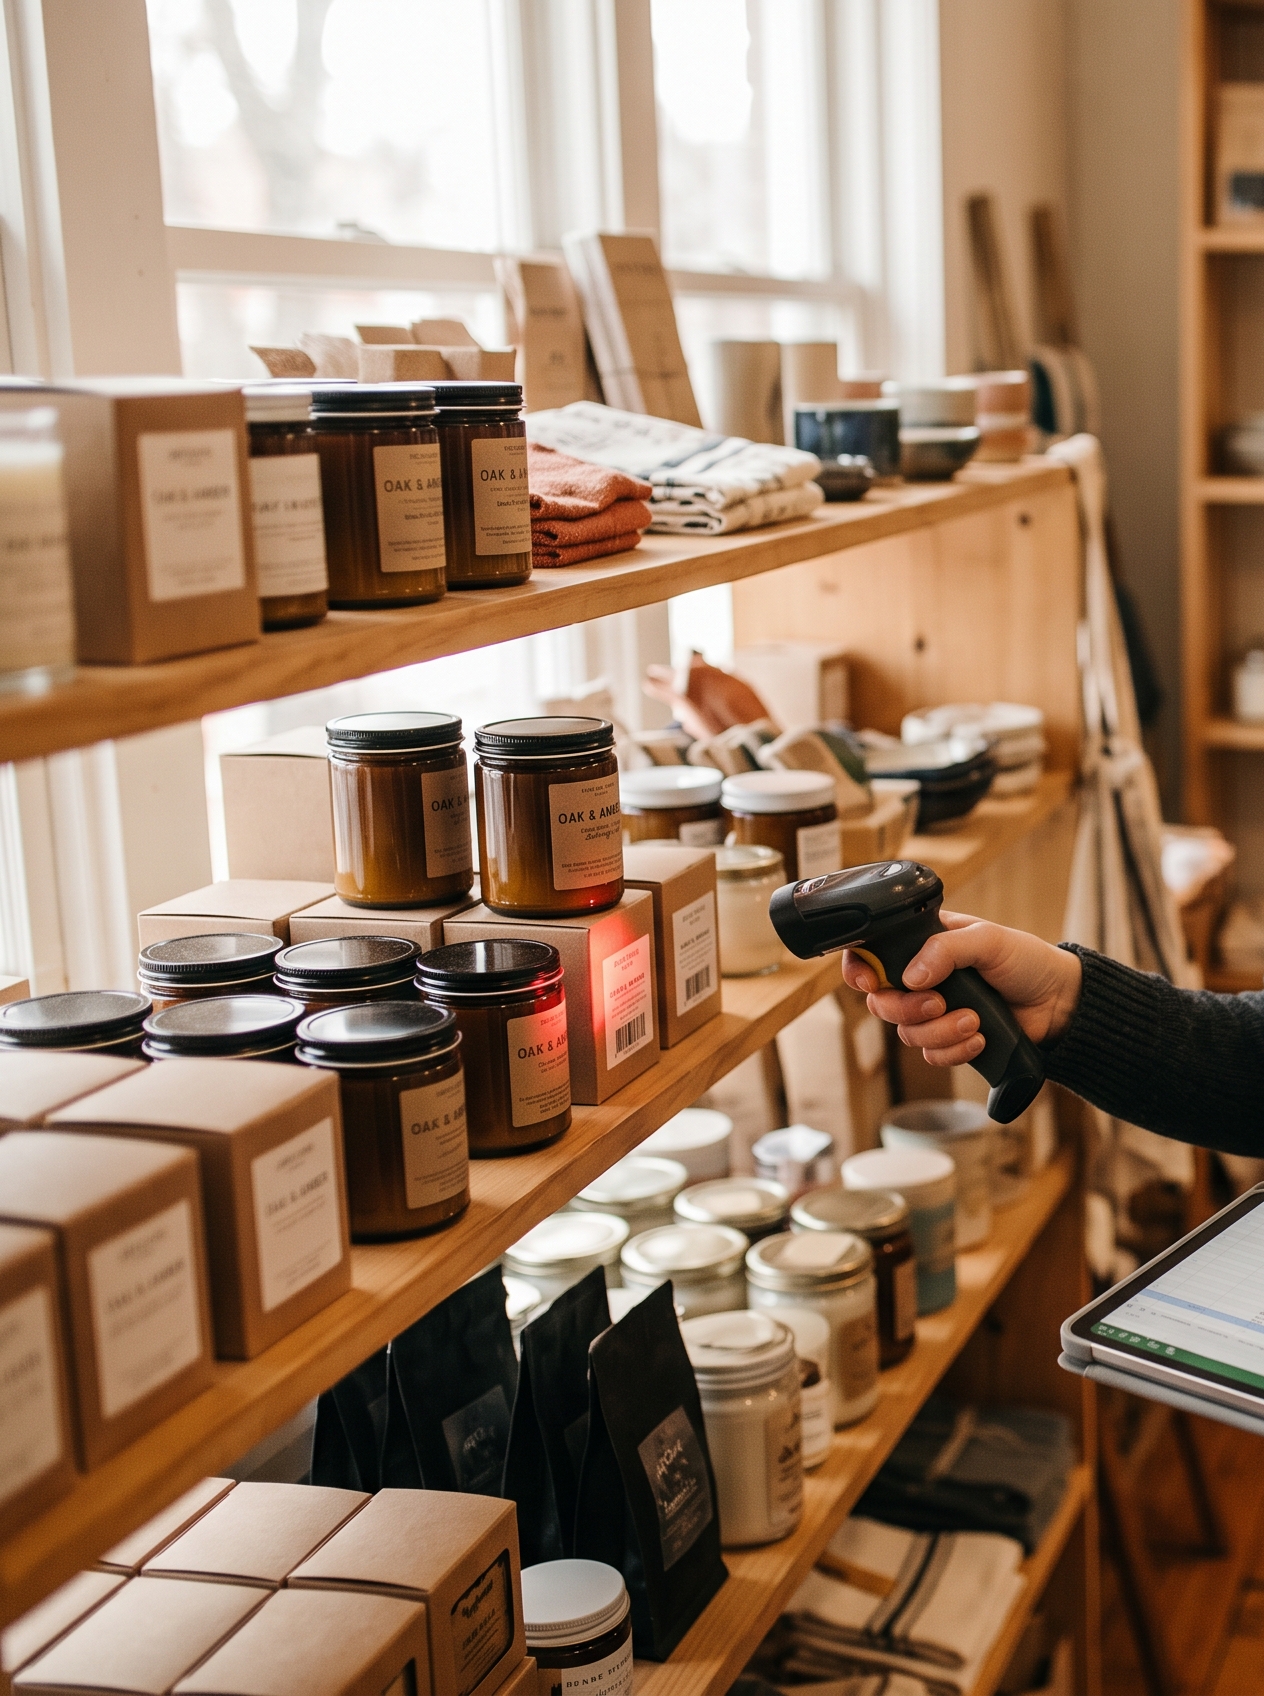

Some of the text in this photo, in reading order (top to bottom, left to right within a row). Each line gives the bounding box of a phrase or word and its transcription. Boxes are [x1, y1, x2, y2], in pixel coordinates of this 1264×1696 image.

[481, 469, 506, 482] OAK
[510, 468, 516, 480] &
[384, 479, 412, 493] OAK
[431, 797, 455, 812] OAK
[558, 807, 585, 825] OAK
[588, 809, 597, 821] &
[517, 1043, 544, 1060] OAK
[547, 1040, 554, 1052] &
[411, 1117, 440, 1136] OAK
